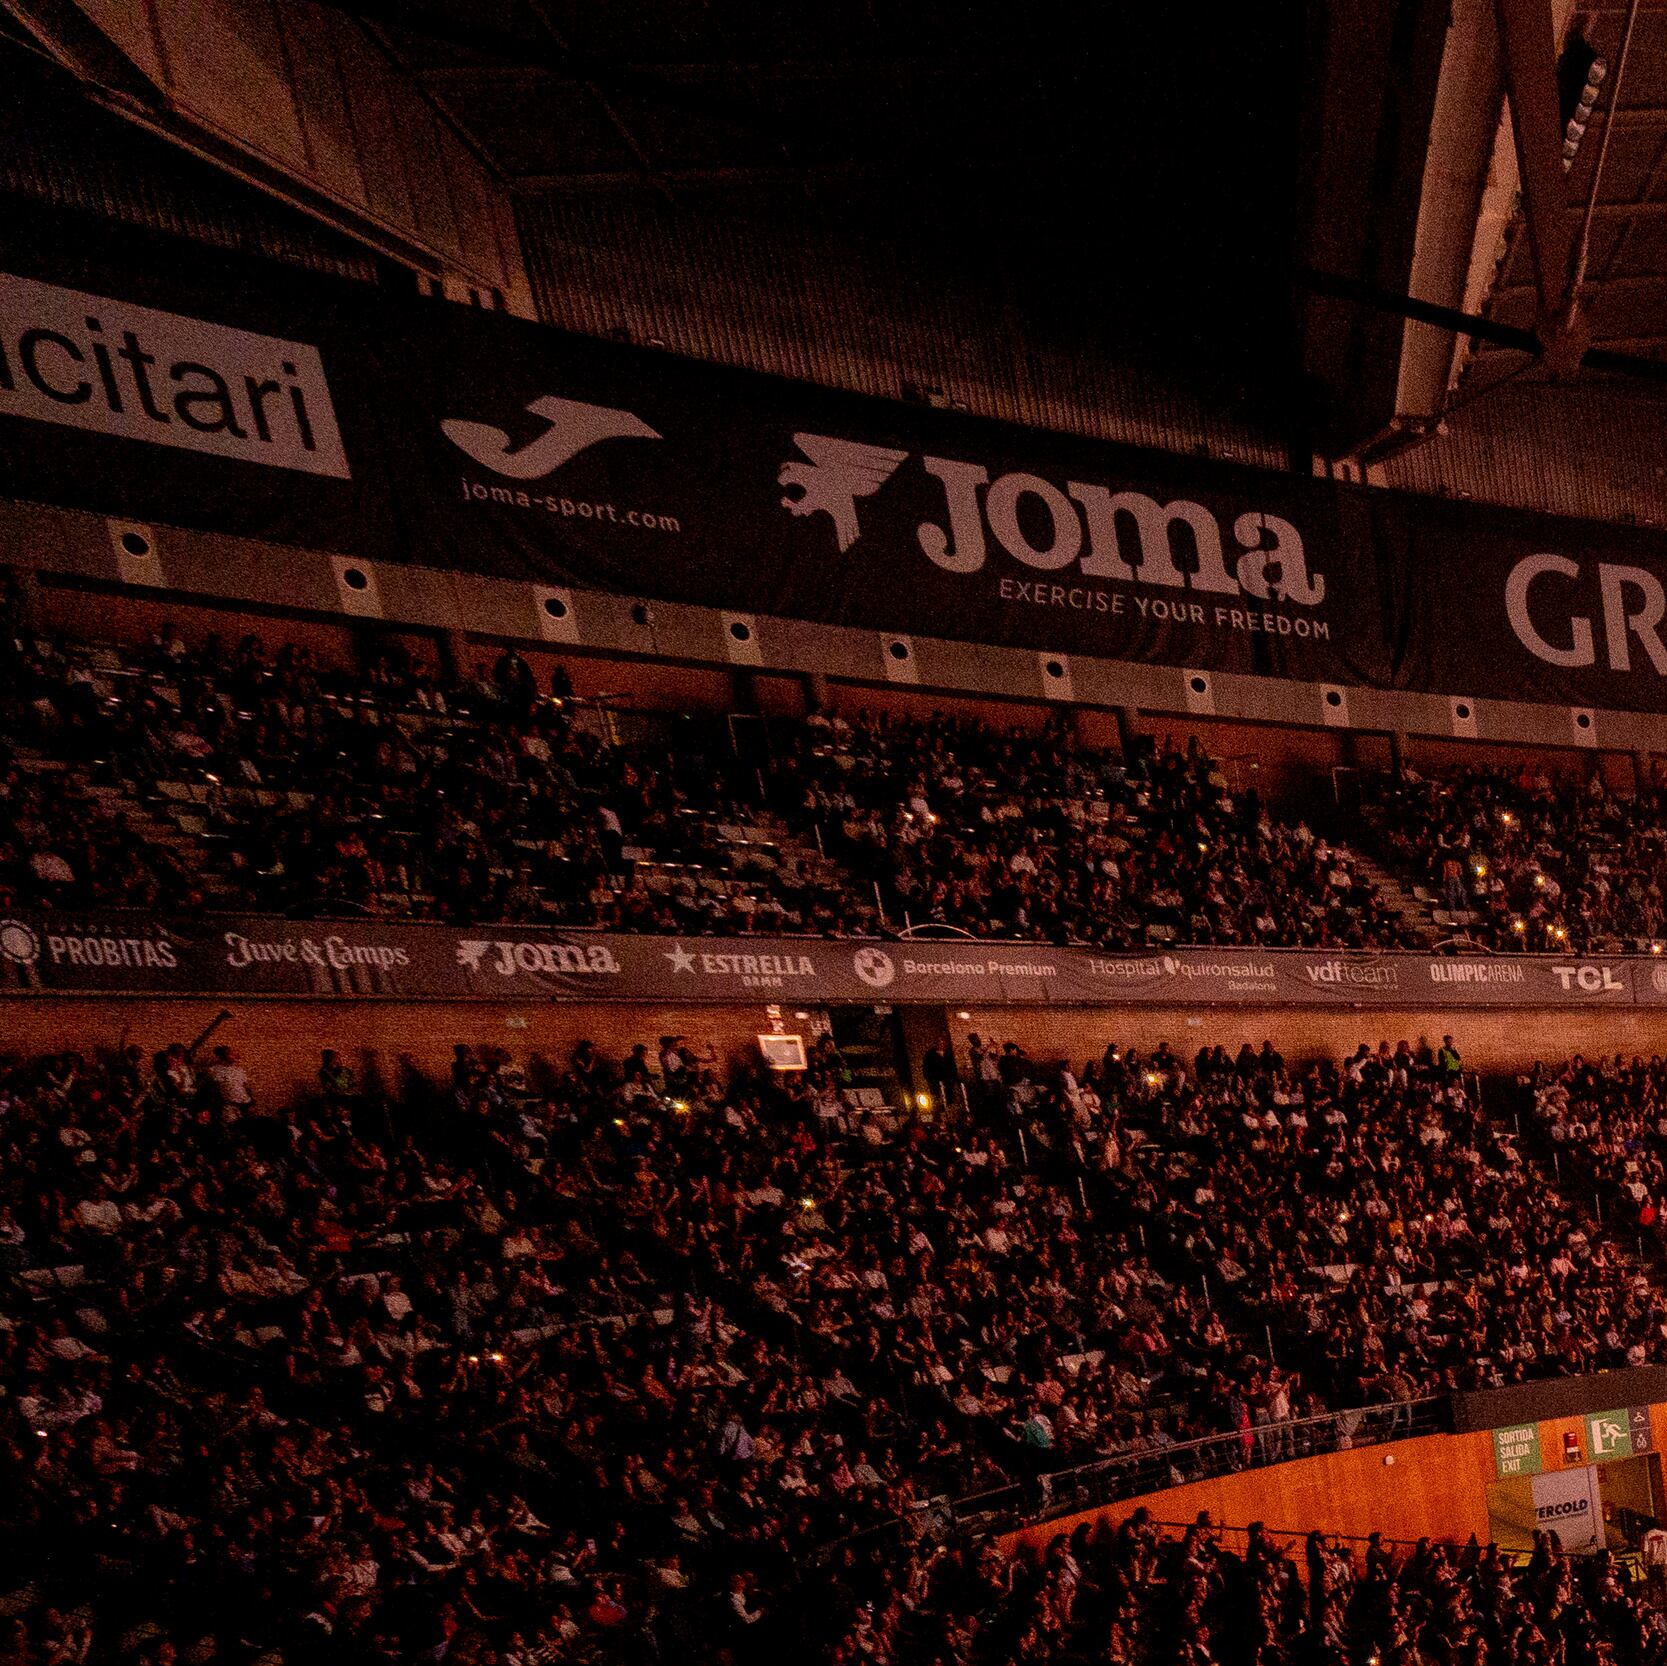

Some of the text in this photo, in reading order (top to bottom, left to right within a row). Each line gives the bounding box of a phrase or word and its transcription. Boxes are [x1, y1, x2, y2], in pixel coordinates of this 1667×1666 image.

[461, 477, 681, 533] joma-sport.com
[1000, 578, 1331, 640] EXERCISE YOUR FREEDOM
[47, 935, 177, 968] PROBITAS
[224, 931, 410, 971] Juvé & Camps
[702, 953, 817, 976] ESTRELLA
[903, 959, 1057, 977] Barcelona Premium
[1089, 958, 1160, 978] Hospital
[741, 975, 783, 987] DAMM
[1228, 980, 1276, 991] Badalona
[1552, 966, 1624, 991] TCL
[1499, 1428, 1534, 1445] SORTIDA
[1500, 1443, 1530, 1459] SALIDA
[1502, 1459, 1521, 1473] EXIT
